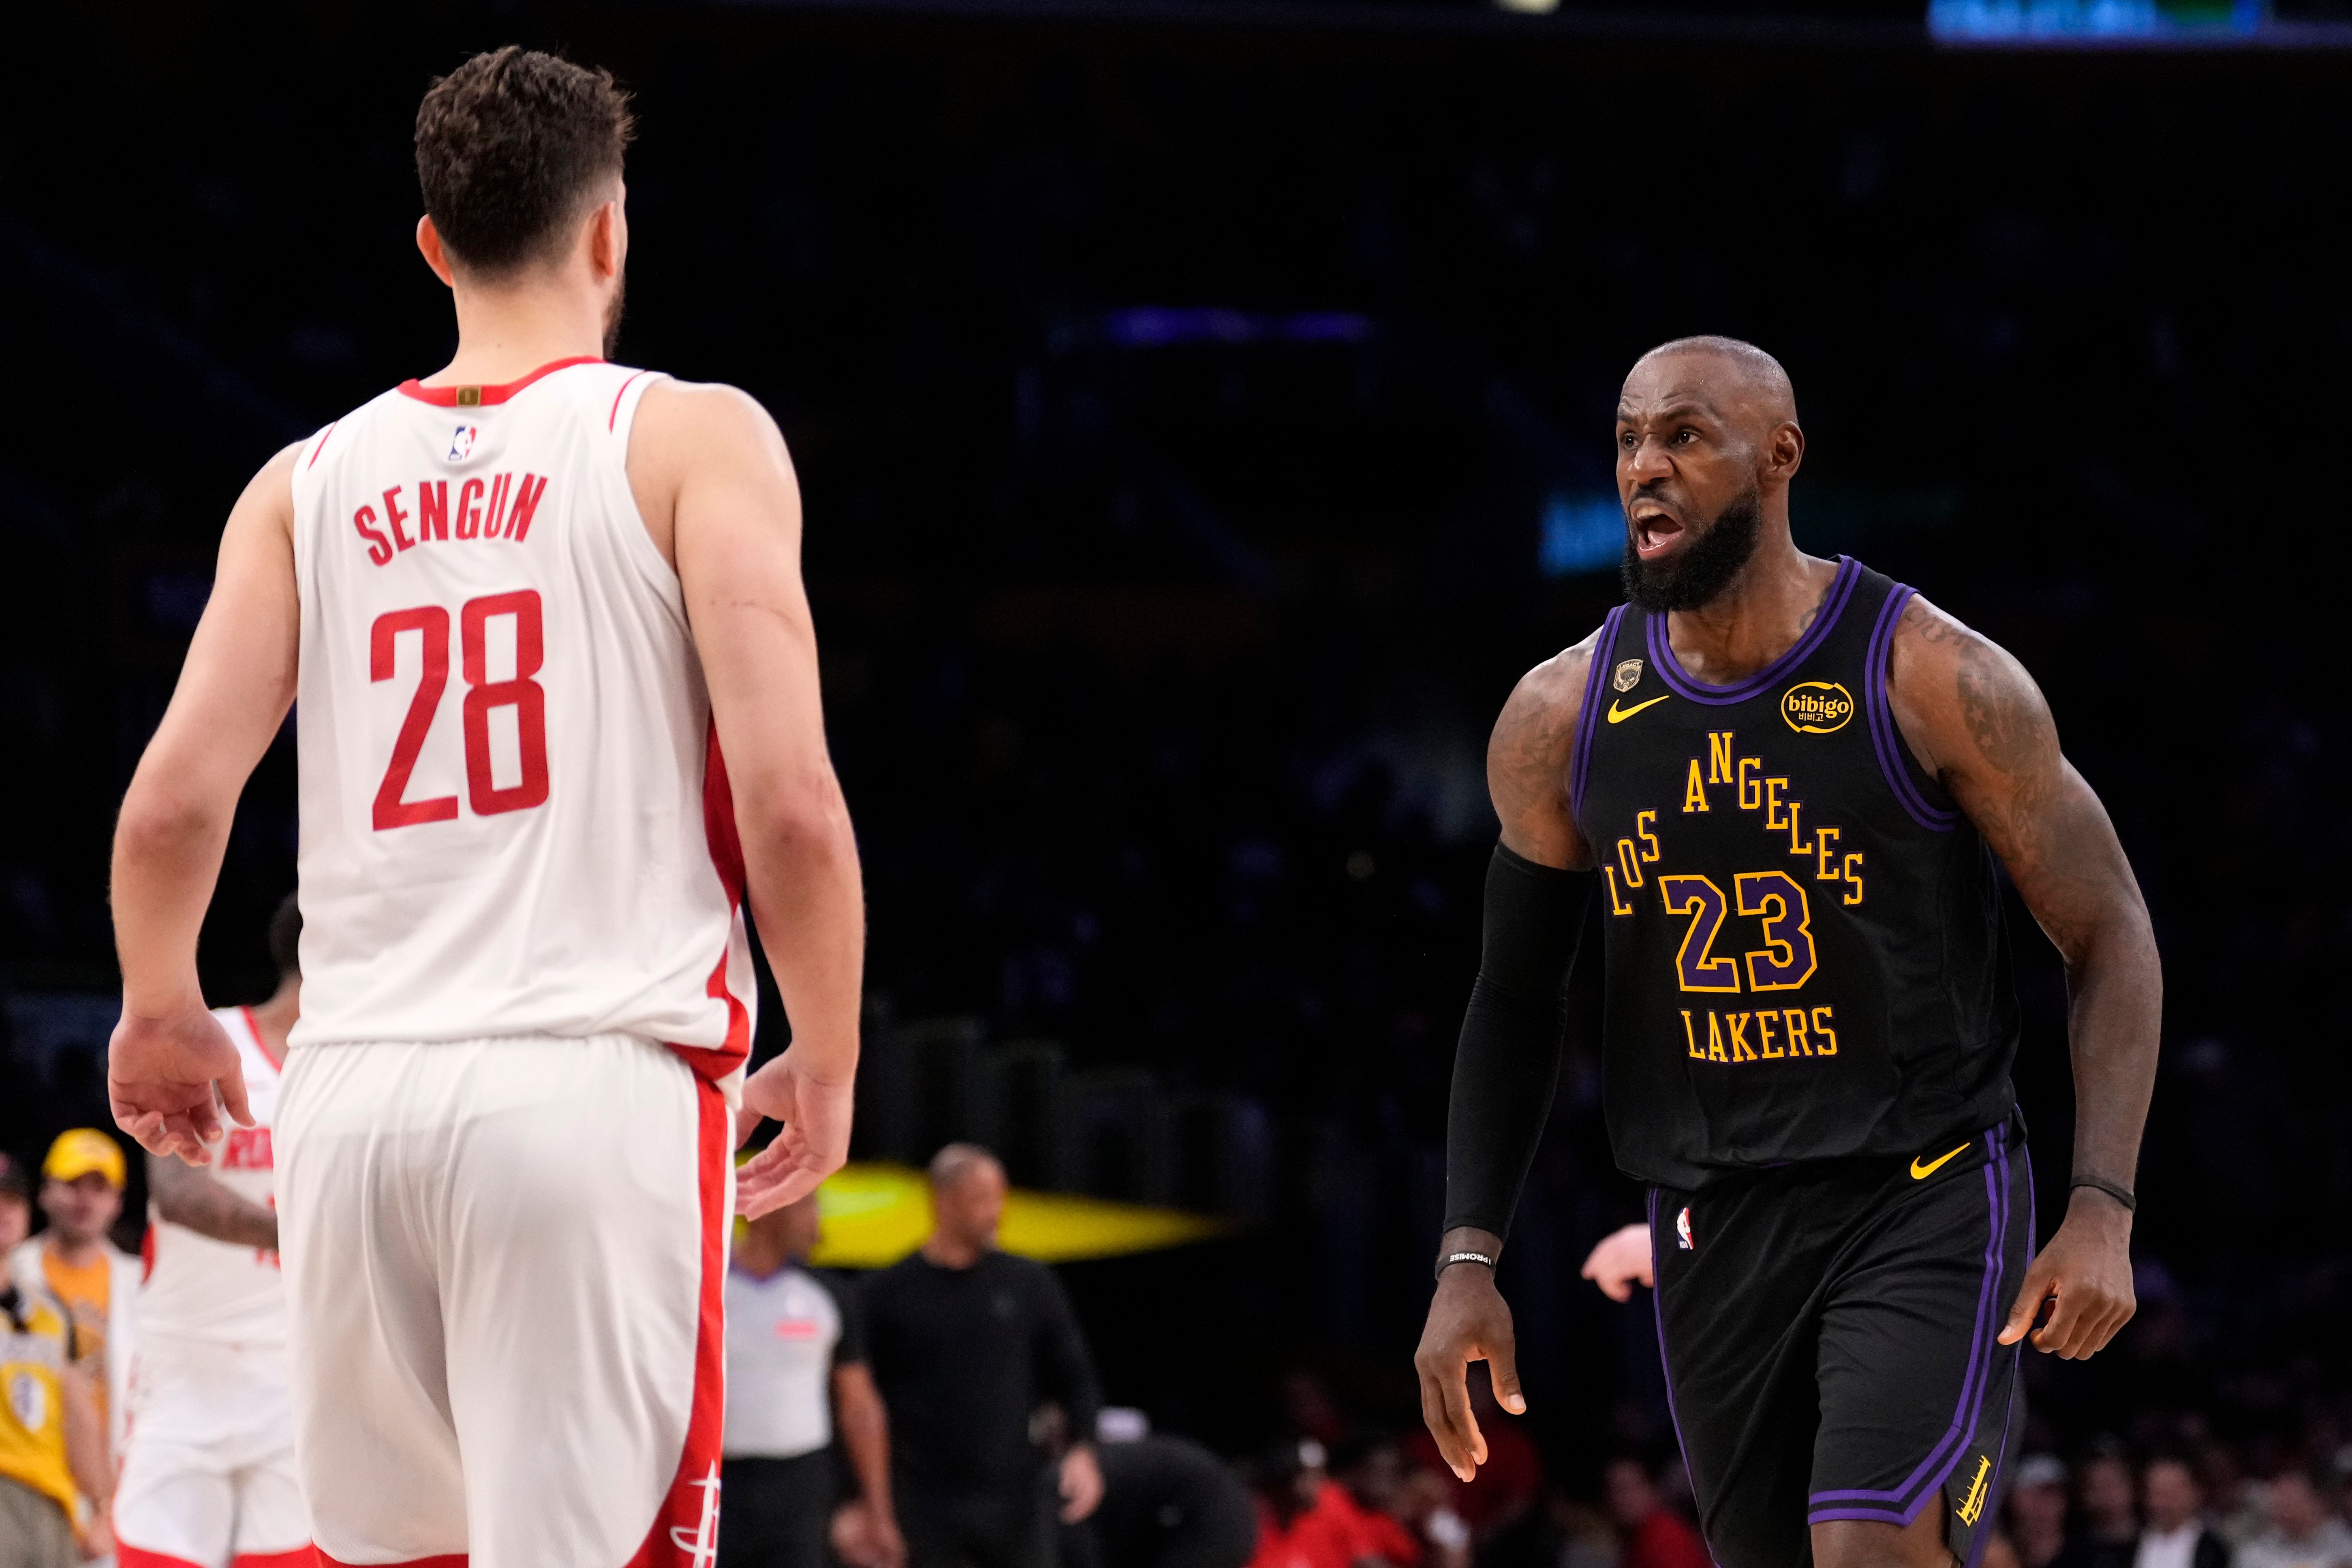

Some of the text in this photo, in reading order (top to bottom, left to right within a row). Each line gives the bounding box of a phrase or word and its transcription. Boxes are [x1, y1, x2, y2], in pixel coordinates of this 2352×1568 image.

[354, 472, 548, 567] SENGUN
[370, 588, 550, 832] 28
[1788, 694, 1850, 719] bibigo
[1798, 712, 1824, 721] 비비고
[1605, 732, 1863, 916] LOS ANGELES
[1658, 870, 1818, 993] 23
[1681, 1006, 1838, 1063] LAKERS
[1450, 1254, 1488, 1263] PROMISE
